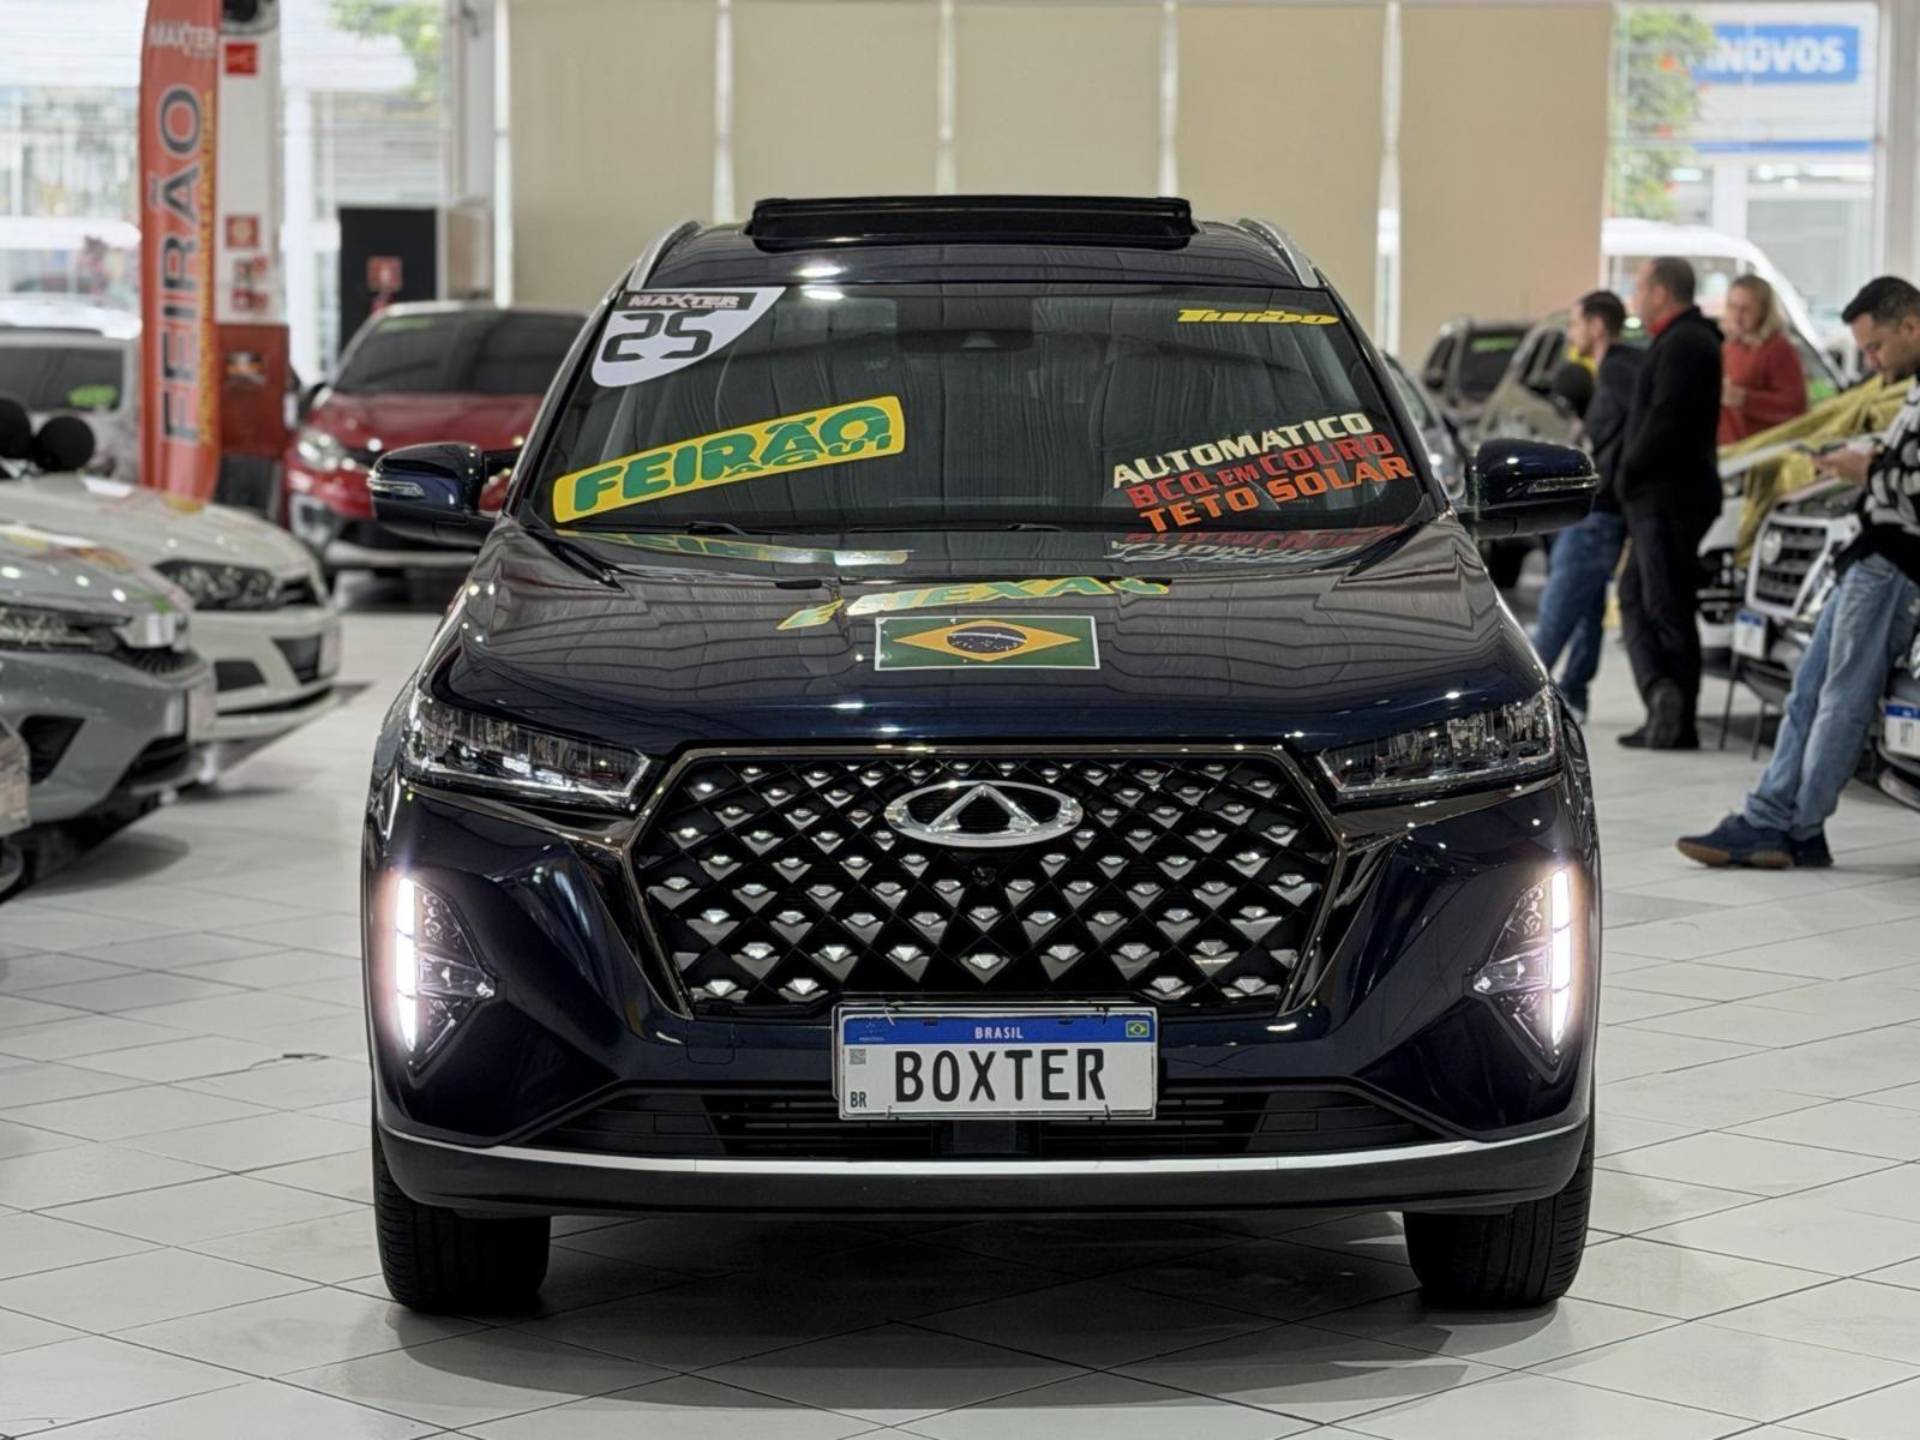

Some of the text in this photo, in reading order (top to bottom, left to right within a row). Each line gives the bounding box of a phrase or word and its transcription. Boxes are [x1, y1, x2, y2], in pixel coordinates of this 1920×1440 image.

[150, 86, 203, 444] FEIRÃO
[628, 294, 740, 309] MAXTER
[1176, 309, 1340, 324] Turbo
[601, 311, 713, 362] 25
[572, 404, 893, 513] FEIRÃO
[1216, 463, 1260, 488] EM
[1258, 433, 1395, 477] COURO
[1139, 455, 1415, 532] TETO SOLAR
[974, 1026, 1024, 1040] BRASIL
[850, 1091, 867, 1108] BR
[894, 1048, 1106, 1103] BOXTER
